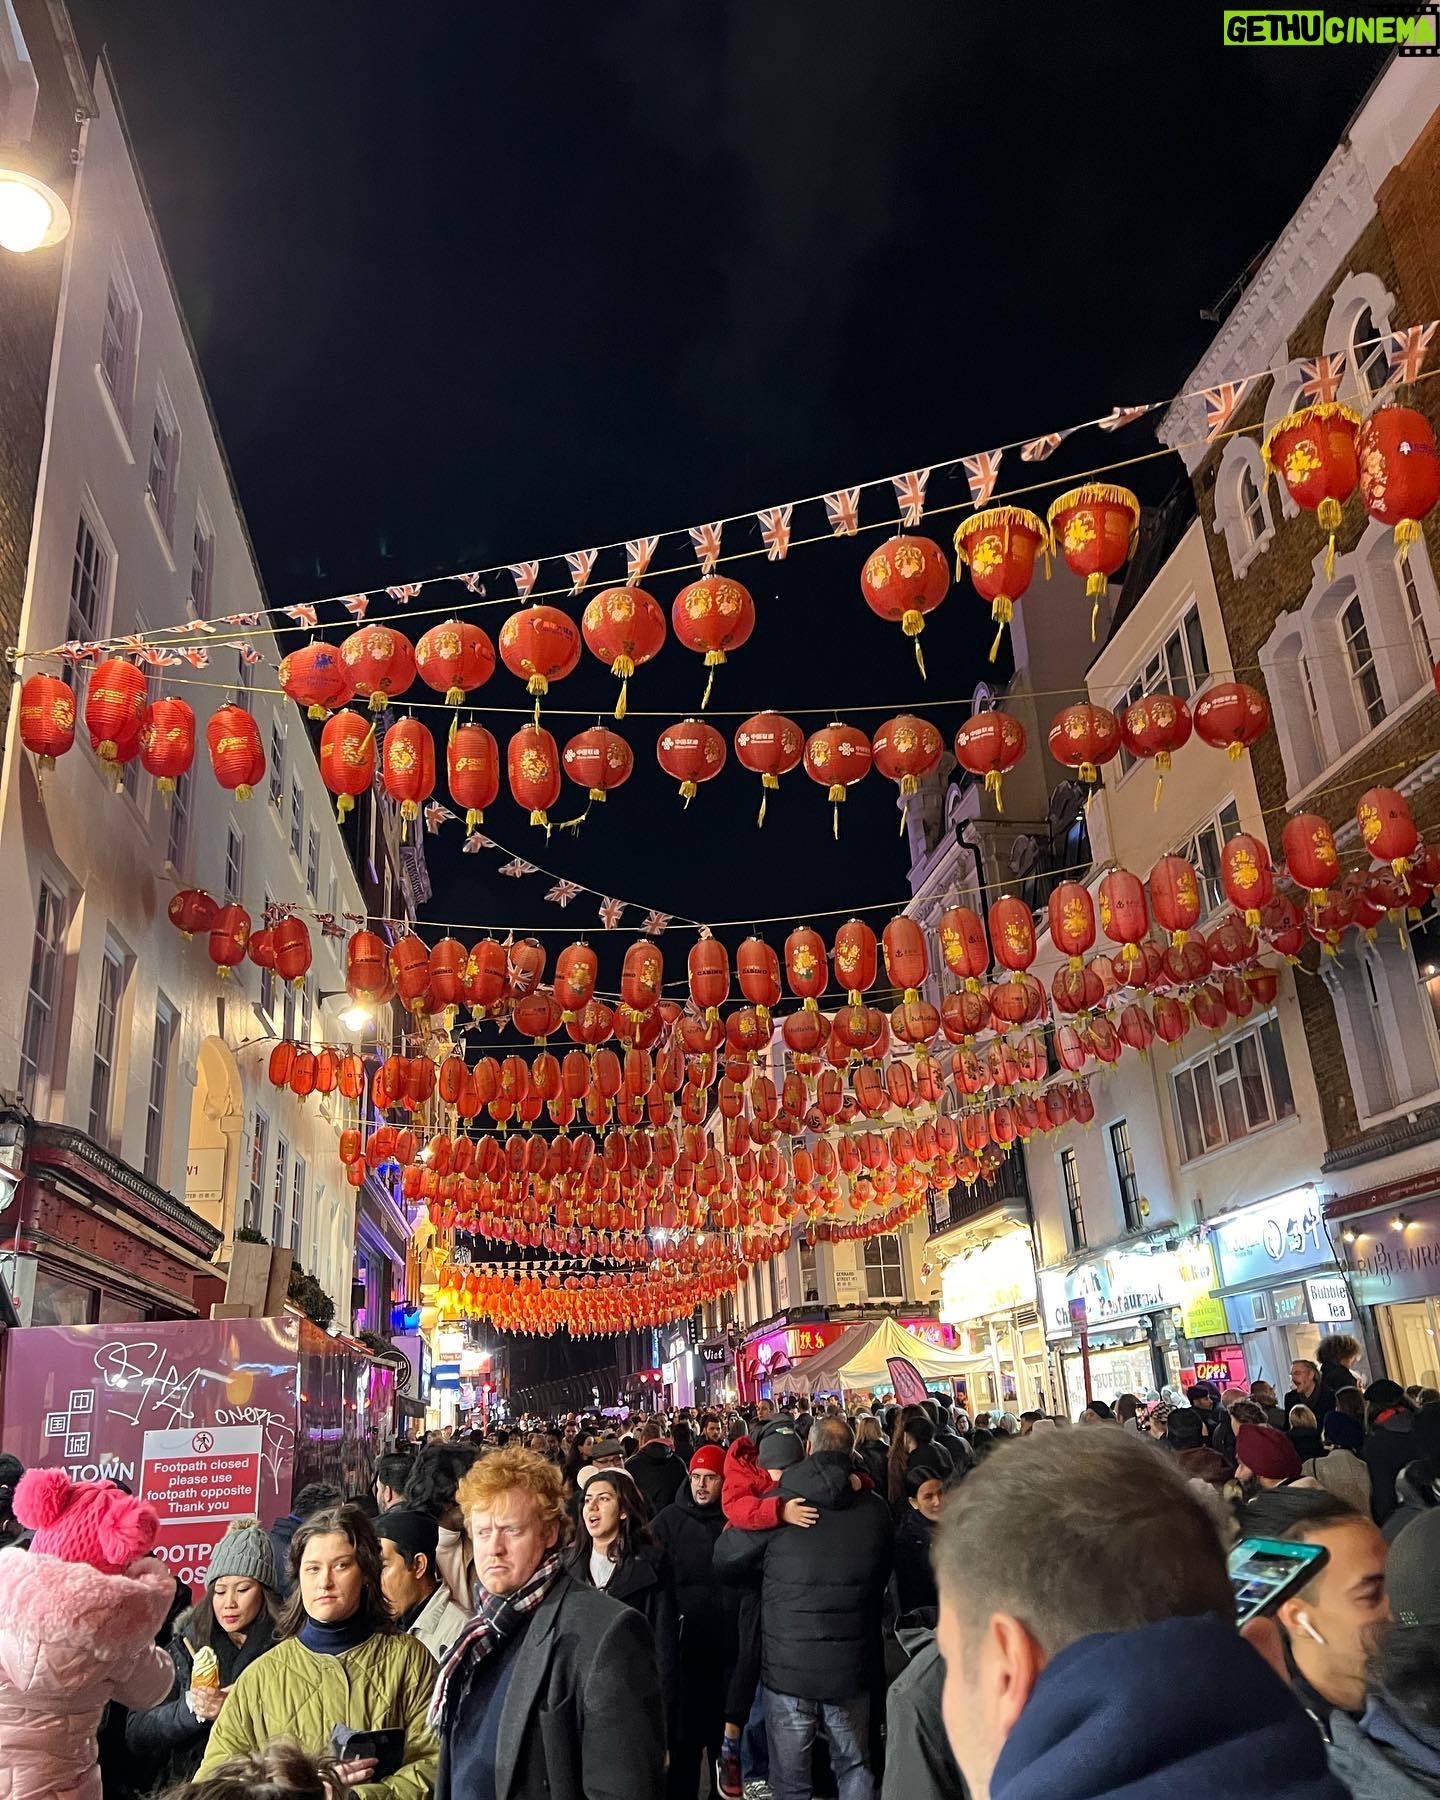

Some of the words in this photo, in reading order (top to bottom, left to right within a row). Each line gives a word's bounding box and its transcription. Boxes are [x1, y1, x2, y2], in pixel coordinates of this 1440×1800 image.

[1310, 1285, 1346, 1300] Bubble
[1328, 1303, 1346, 1318] Tea
[154, 1460, 207, 1473] Footpath
[210, 1458, 249, 1470] closed
[168, 1476, 208, 1488] please
[211, 1474, 232, 1484] use
[147, 1488, 197, 1501] footpath
[201, 1485, 252, 1499] opposite
[168, 1501, 205, 1513] Thank
[207, 1501, 230, 1512] you
